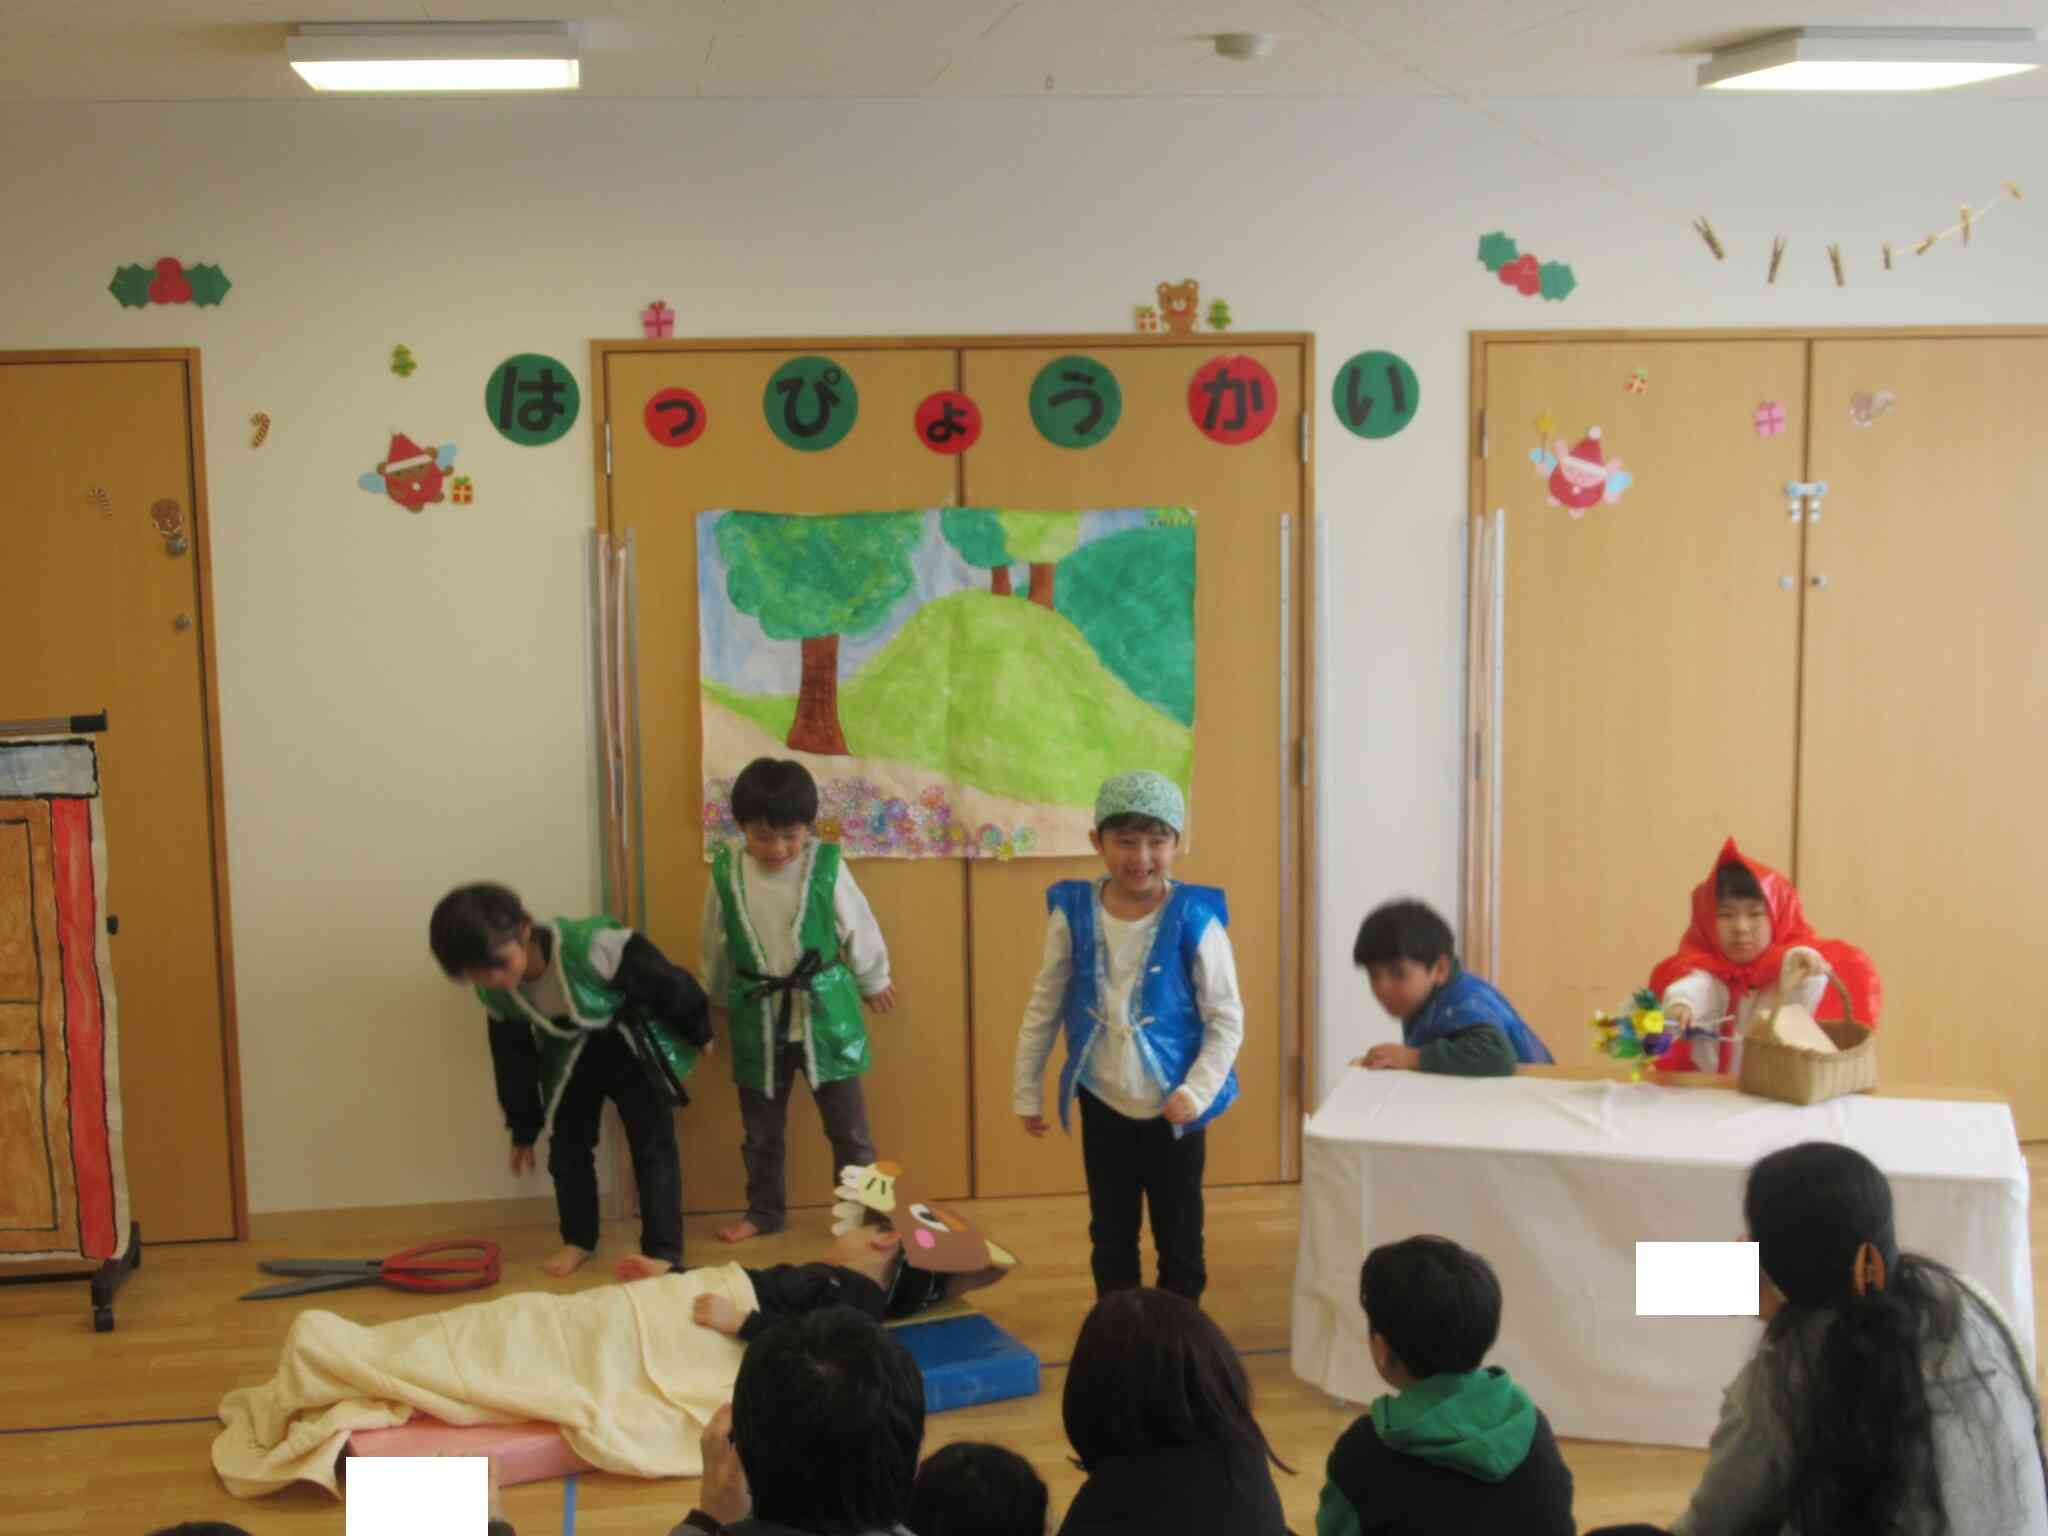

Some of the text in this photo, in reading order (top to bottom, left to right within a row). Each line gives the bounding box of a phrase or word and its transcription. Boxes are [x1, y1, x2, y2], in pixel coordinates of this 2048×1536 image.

[500, 364, 1406, 443] はっぴょうかい
